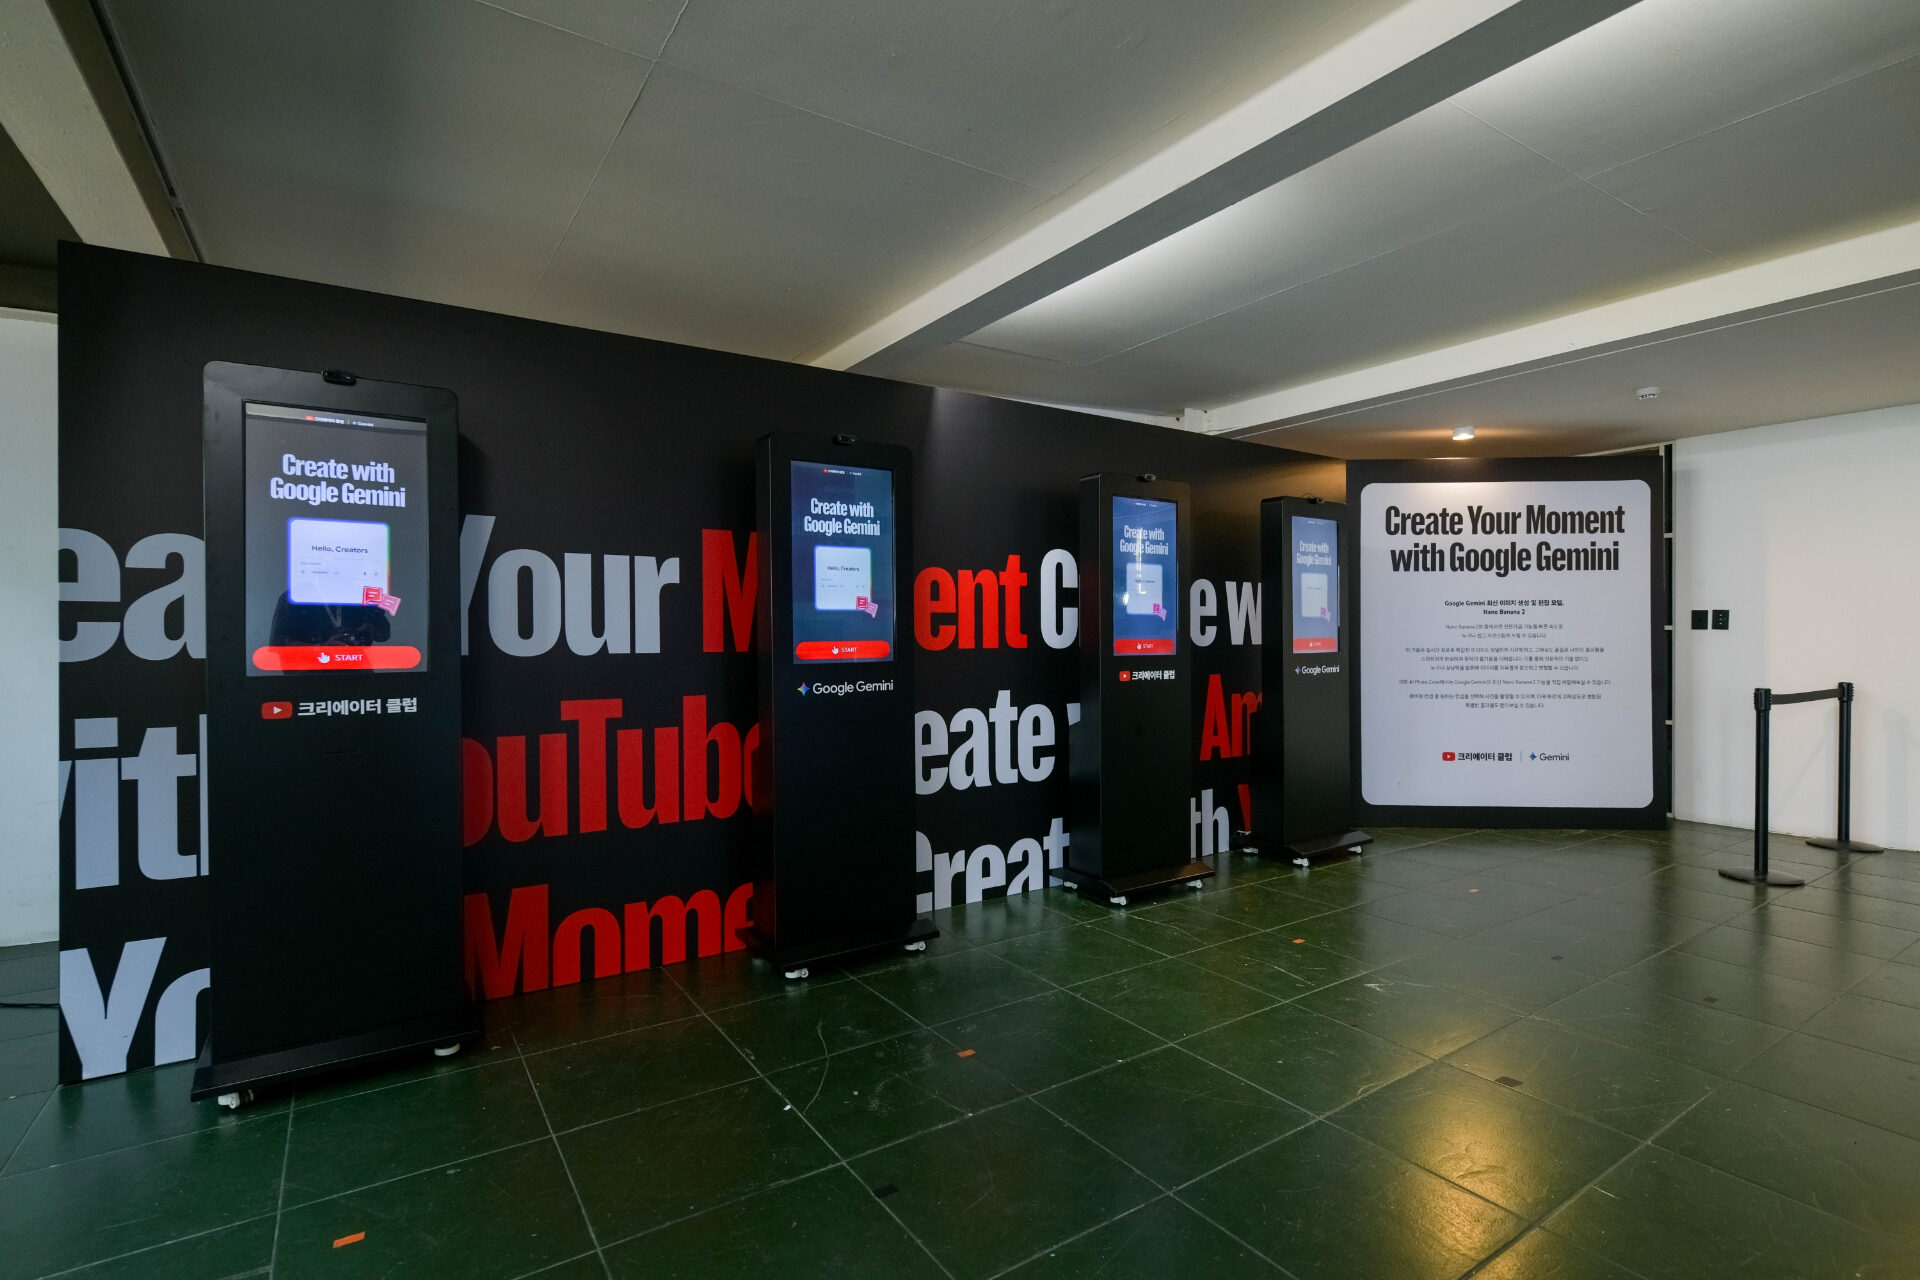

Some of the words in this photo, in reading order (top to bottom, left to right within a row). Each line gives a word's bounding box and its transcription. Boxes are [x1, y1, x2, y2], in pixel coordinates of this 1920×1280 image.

[282, 453, 349, 479] Create
[351, 461, 395, 483] with
[270, 477, 339, 506] Google
[341, 482, 406, 508] Gemini
[810, 498, 848, 516] Create
[848, 501, 874, 518] with
[804, 515, 842, 536] Google
[843, 518, 880, 536] Gemini
[1385, 505, 1463, 536] Create
[1467, 505, 1521, 535] Your
[1526, 504, 1625, 534] Moment
[1148, 528, 1165, 541] with
[1120, 539, 1144, 555] Googe
[1145, 541, 1169, 555] Gemini
[1391, 542, 1445, 572] with
[1449, 541, 1531, 577] Google
[1536, 541, 1620, 571] Gemini
[335, 654, 363, 662] START
[1131, 670, 1162, 680] 크리에이터
[1301, 665, 1321, 675] Google
[1321, 664, 1340, 673] Gemini
[812, 681, 854, 696] Google
[856, 679, 894, 692] Gemini
[297, 699, 382, 716] 크리에이터
[386, 697, 417, 714] 클럽
[1457, 752, 1495, 761] 크리에이터
[1497, 752, 1513, 761] 클럽
[1539, 752, 1570, 761] Gemini
